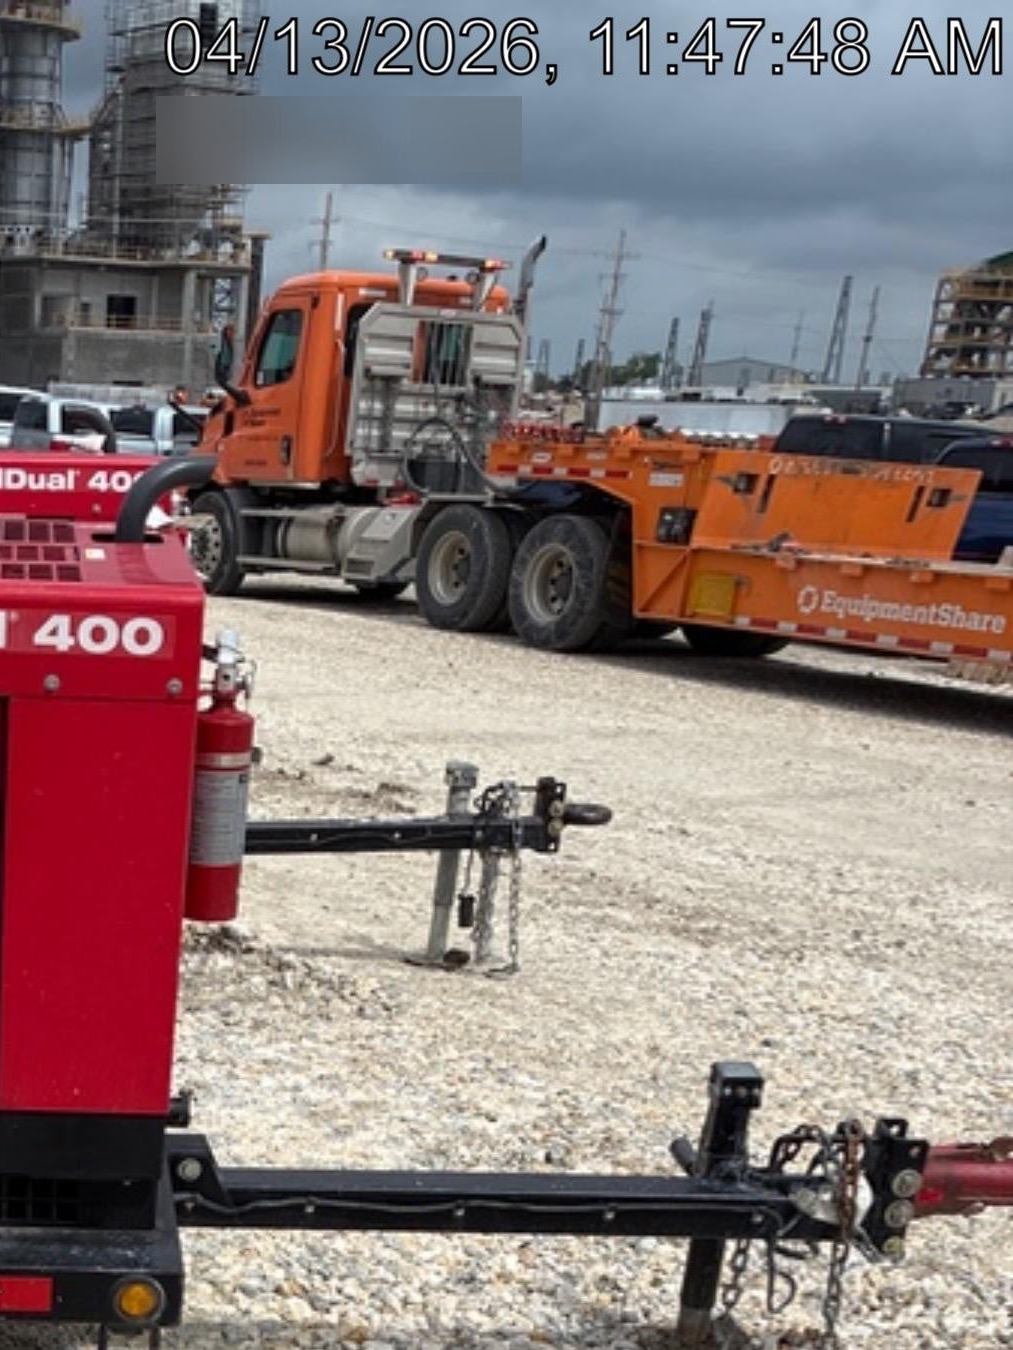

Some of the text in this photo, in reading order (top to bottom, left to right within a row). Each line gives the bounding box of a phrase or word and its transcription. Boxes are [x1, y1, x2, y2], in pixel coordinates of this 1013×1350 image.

[87, 469, 145, 493] 40
[820, 589, 1007, 635] EquipmentShare
[33, 614, 165, 656] 400
